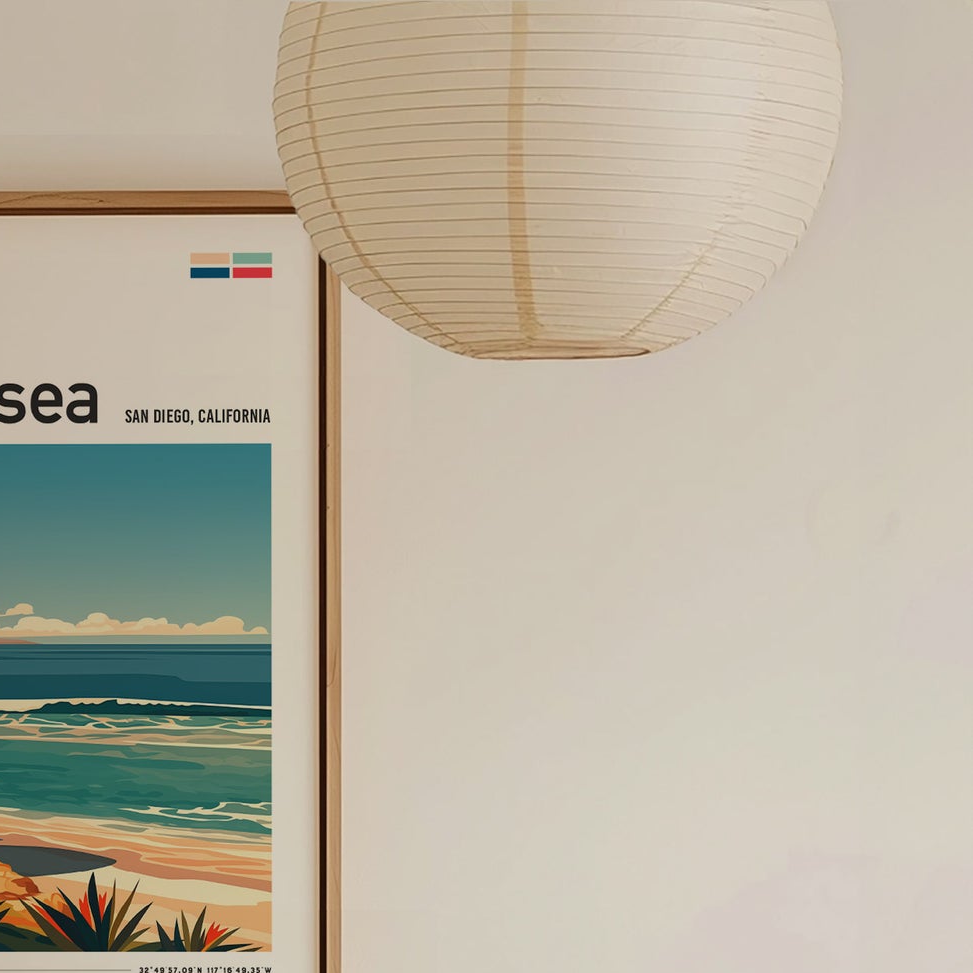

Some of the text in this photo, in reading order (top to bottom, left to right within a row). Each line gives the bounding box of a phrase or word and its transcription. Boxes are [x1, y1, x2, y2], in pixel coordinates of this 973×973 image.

[125, 409, 270, 425] SAN DIEGO, CALIFORNIA
